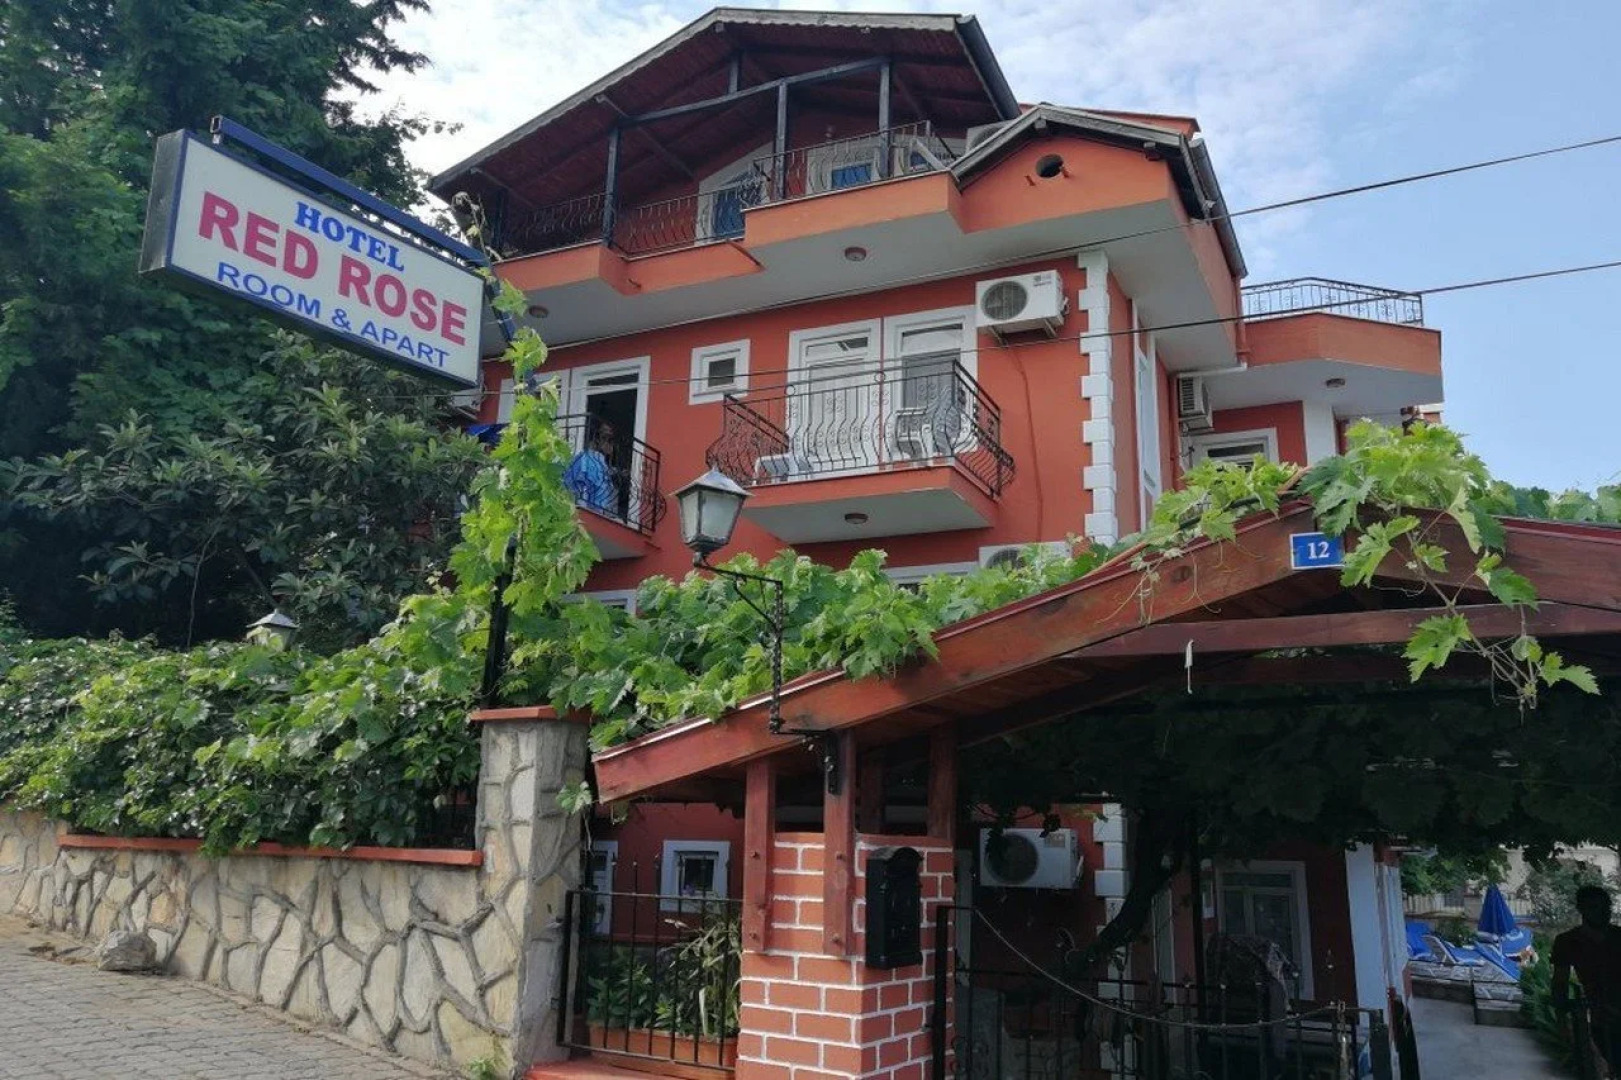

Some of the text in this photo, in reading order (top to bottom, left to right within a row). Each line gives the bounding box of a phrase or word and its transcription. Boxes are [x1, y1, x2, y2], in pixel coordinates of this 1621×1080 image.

[198, 191, 467, 346] RED ROSE
[295, 201, 405, 272] HOTEL
[216, 262, 449, 368] ROOM & APART
[1307, 541, 1331, 559] 12
